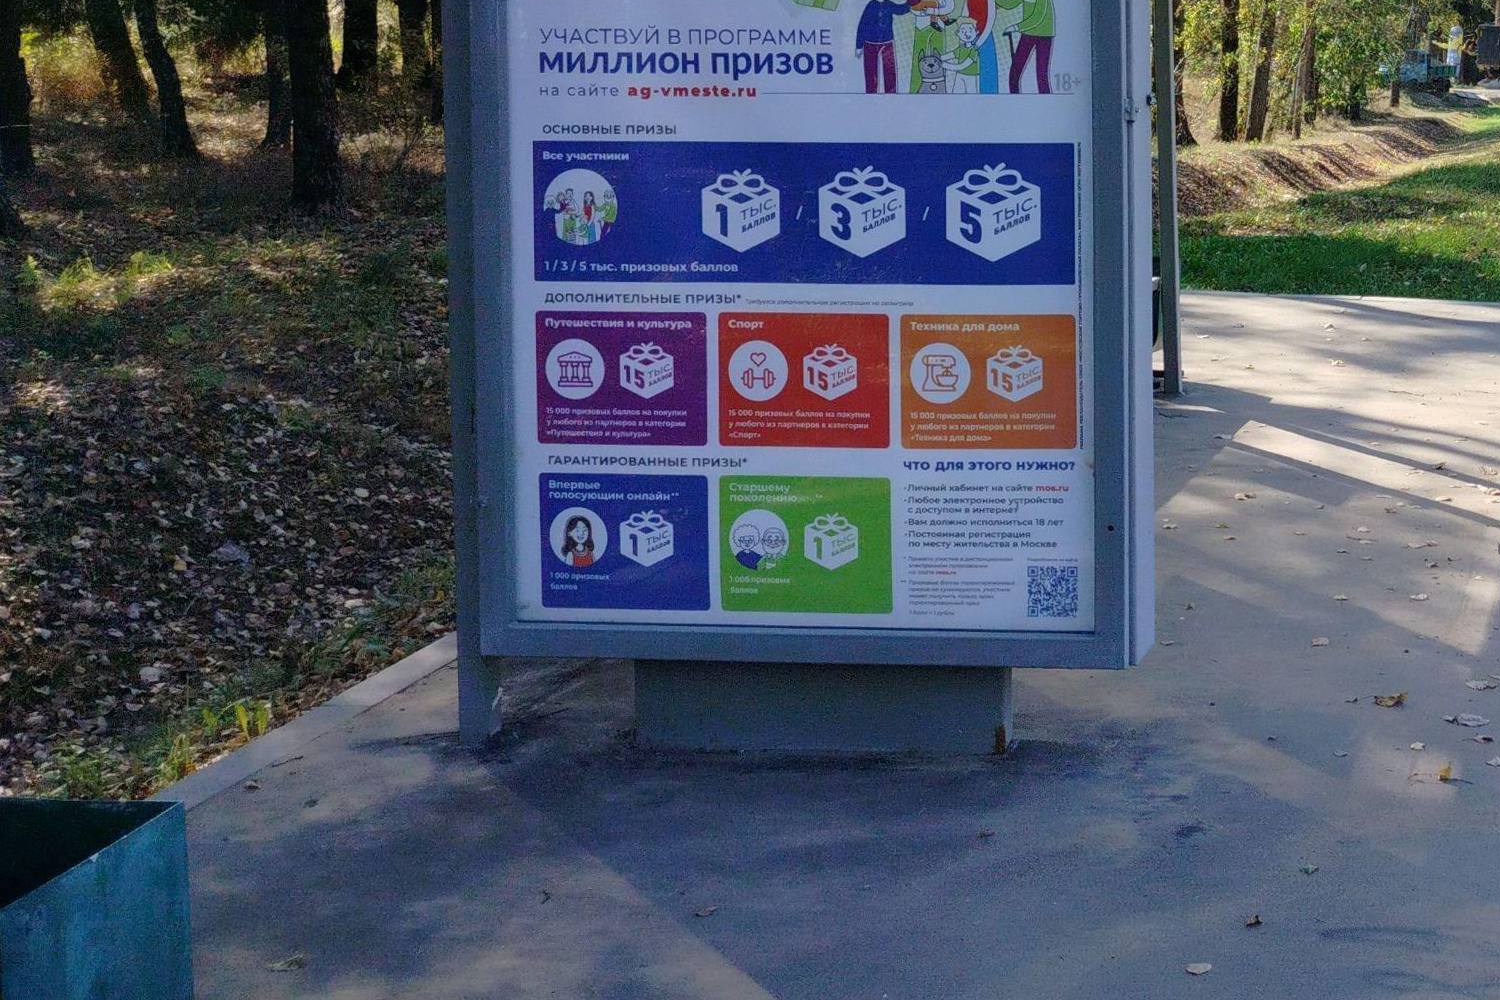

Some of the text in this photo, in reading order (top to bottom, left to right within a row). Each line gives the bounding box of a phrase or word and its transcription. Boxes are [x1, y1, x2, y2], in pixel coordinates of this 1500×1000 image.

[539, 25, 832, 46] УЧАСТВУЙ В ПРОГРАММЕ
[711, 51, 834, 80] призов
[1053, 72, 1081, 93] 18+
[539, 82, 757, 100] на сайте ag-vmeste.ru
[542, 124, 677, 136] ОСНОВНЫЕ ПРИЗЫ
[542, 151, 630, 164] Все участники
[739, 198, 778, 222] ТЫС.
[861, 198, 902, 224] ТЫС.
[992, 197, 1038, 225] ТЫС.
[714, 203, 729, 238] 1
[740, 211, 777, 234] БАЛЛОВ
[830, 202, 852, 241] 3
[862, 213, 897, 234] БАЛЛОВ
[960, 200, 983, 245] 5
[993, 213, 1032, 236] БАЛЛОВ
[590, 263, 617, 273] тыс.
[620, 263, 687, 275] призовых
[691, 261, 739, 273] баллов
[544, 293, 681, 305] ДОПОЛНИТЕЛЬНЫЕ
[545, 317, 693, 331] Путешествия и культура
[728, 319, 765, 330] Спорт
[910, 321, 1020, 333] Техника для дома
[623, 365, 645, 389] 15
[806, 365, 828, 393] 15
[990, 367, 1014, 393] 15
[548, 455, 689, 468] ГАРАНТИРОВАННЫЕ
[903, 460, 1076, 473] ЧТО ДЛЯ ЭТОГО НУЖНО?
[548, 479, 601, 491] Впервые
[729, 482, 791, 494] Старшему
[907, 484, 947, 493] Личный
[949, 484, 990, 493] кабинет
[1005, 484, 1034, 493] сайте
[1035, 485, 1069, 494] mos.ru
[549, 491, 624, 502] голосующим
[907, 496, 1065, 507] Любое электронное устройство
[915, 506, 963, 516] доступом
[972, 506, 1019, 515] интернет
[907, 518, 1064, 528] Вам должно исполниться 18 лет
[907, 530, 1031, 541] Постоянная регистрация
[629, 533, 639, 558] 1
[813, 536, 824, 560] 1
[908, 541, 921, 549] по
[922, 541, 951, 550] месту
[953, 540, 1011, 549] жительства
[1020, 540, 1058, 549] Москве
